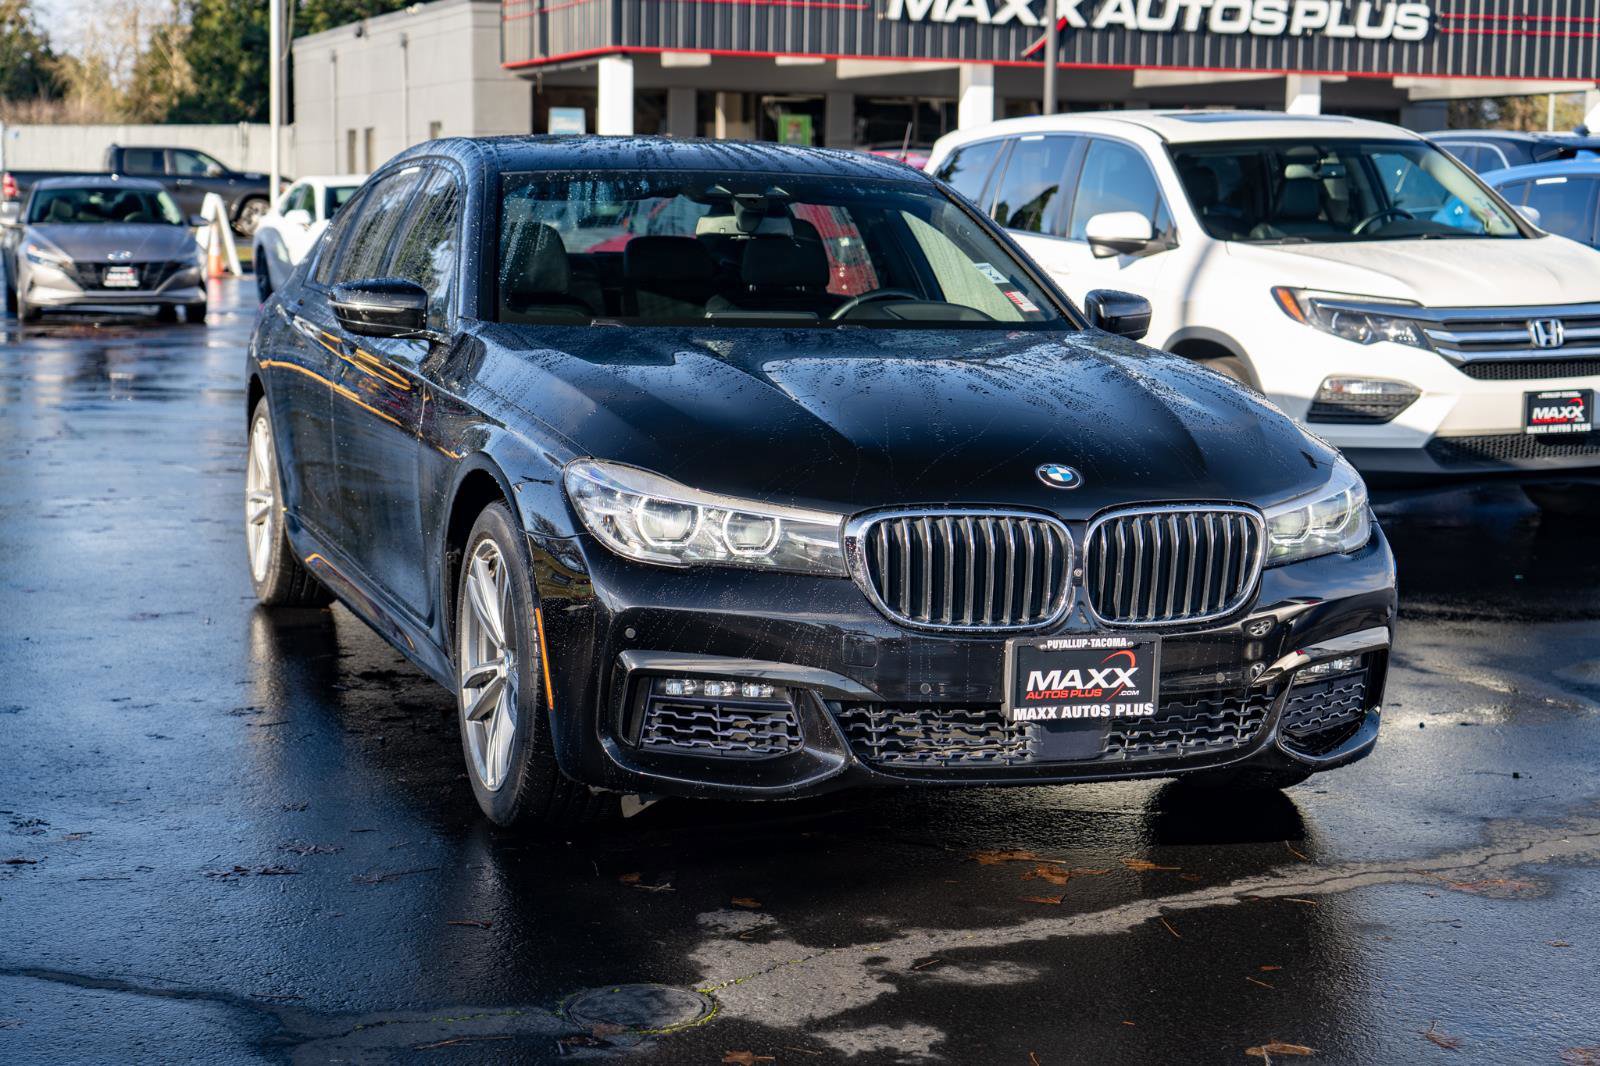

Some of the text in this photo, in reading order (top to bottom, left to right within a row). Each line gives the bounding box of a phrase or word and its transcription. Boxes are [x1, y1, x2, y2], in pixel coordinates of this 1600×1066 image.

[1092, 0, 1288, 36] AUTOS
[1289, 1, 1431, 41] PLUS
[1532, 405, 1585, 419] MAXX
[1026, 667, 1139, 692] MAXX
[1025, 689, 1069, 700] AUTOS
[1069, 688, 1103, 699] PLUS
[1013, 703, 1154, 721] MAXX AUTOS PLUS
